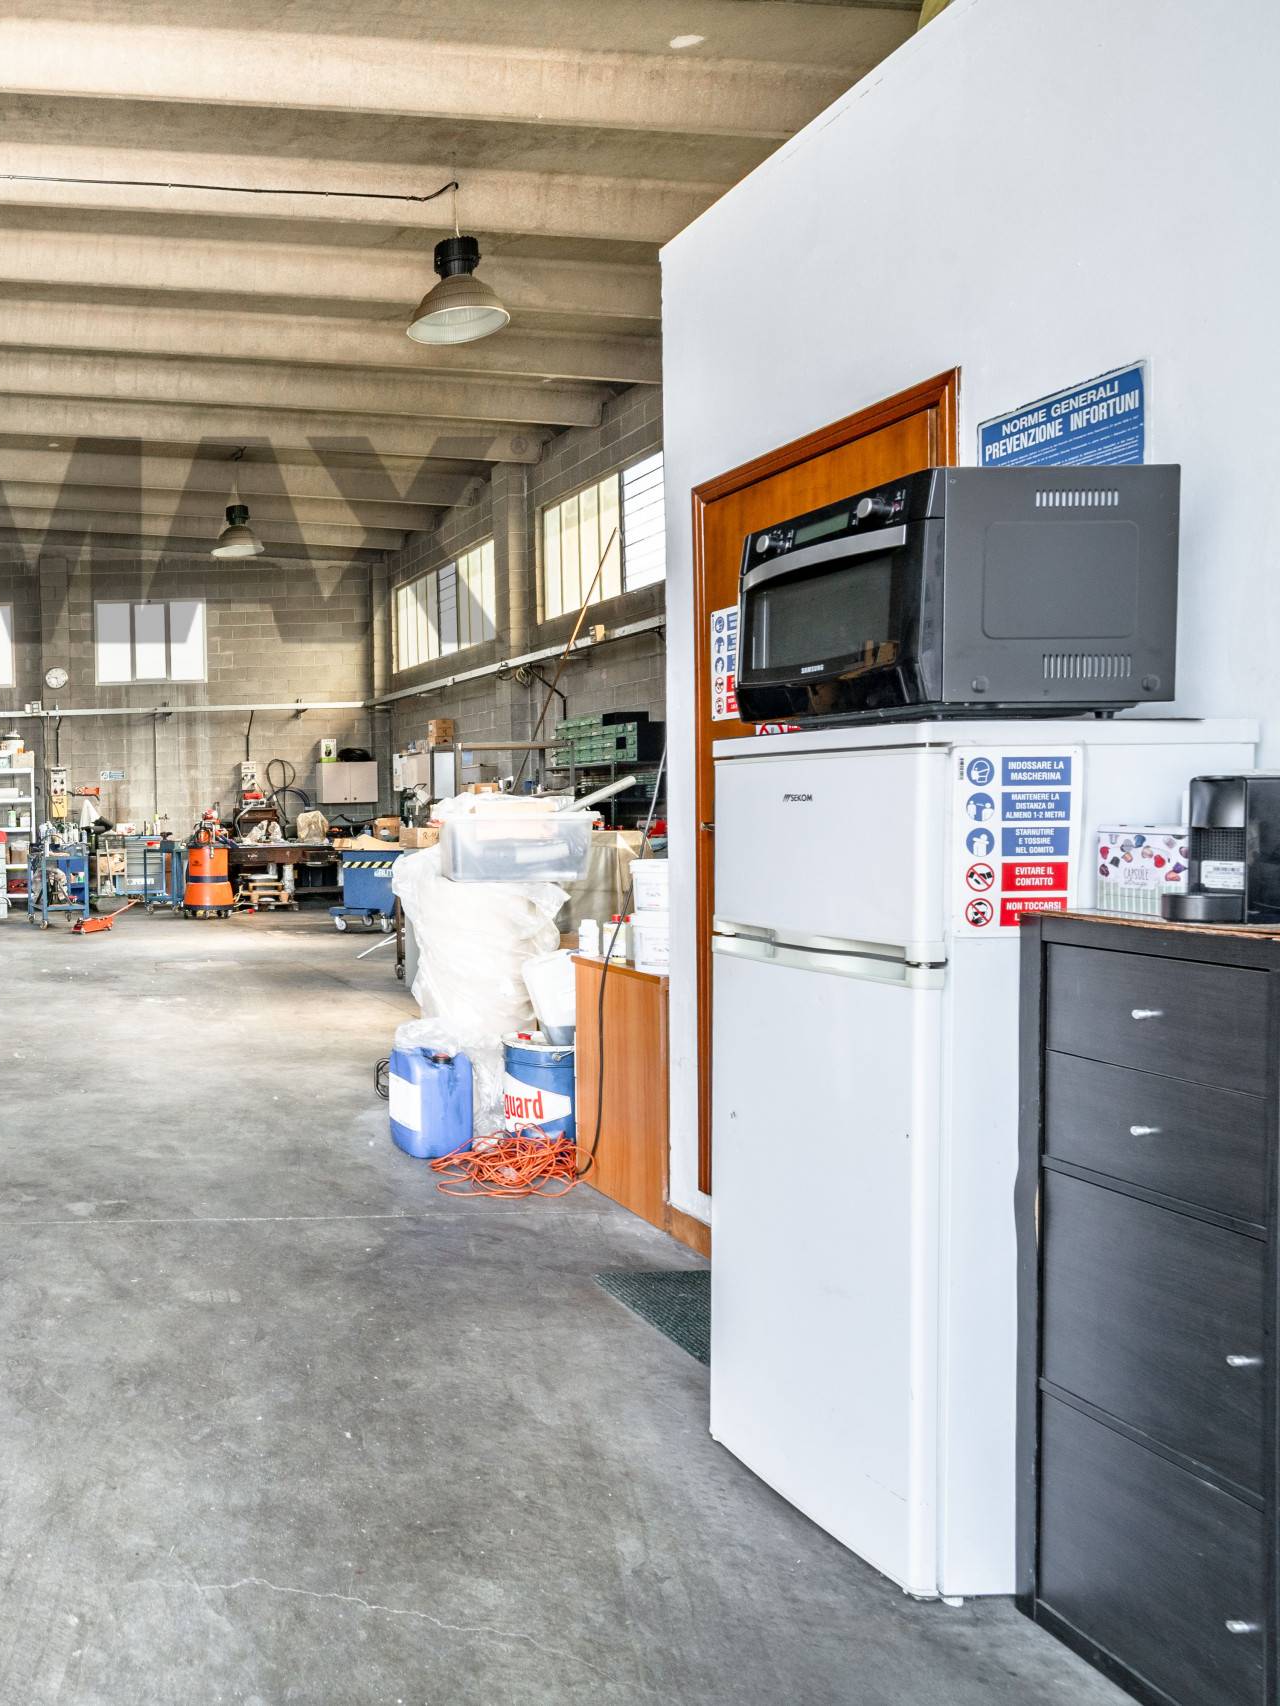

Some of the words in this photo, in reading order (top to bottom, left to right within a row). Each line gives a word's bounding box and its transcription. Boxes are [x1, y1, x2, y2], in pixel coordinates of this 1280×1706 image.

[1001, 408, 1048, 437] NORME
[1050, 380, 1119, 415] GENERALI
[984, 417, 1064, 463] PREVENZIONE
[1069, 388, 1140, 432] INFORTUNI
[1007, 761, 1054, 770] INDOSSARE
[1054, 760, 1065, 769] LA
[1010, 771, 1062, 781] MASCHERINA
[1011, 793, 1050, 801] MANTENERE
[1051, 793, 1060, 801] LA
[1015, 802, 1047, 810] DISTANZA
[1005, 811, 1032, 819] ALMENO
[1033, 811, 1044, 819] 1-2
[1044, 811, 1066, 819] METRI
[1015, 828, 1055, 836] STARNUTIRE
[1018, 837, 1023, 845] E
[1024, 837, 1051, 845] TOSSIRE
[1028, 846, 1054, 854] GOMITO
[1015, 867, 1046, 875] EVITARE
[1046, 867, 1054, 875] IL
[1015, 877, 1054, 886] CONTATTO
[1006, 901, 1023, 911] NON
[1023, 901, 1062, 911] TOCCARSI
